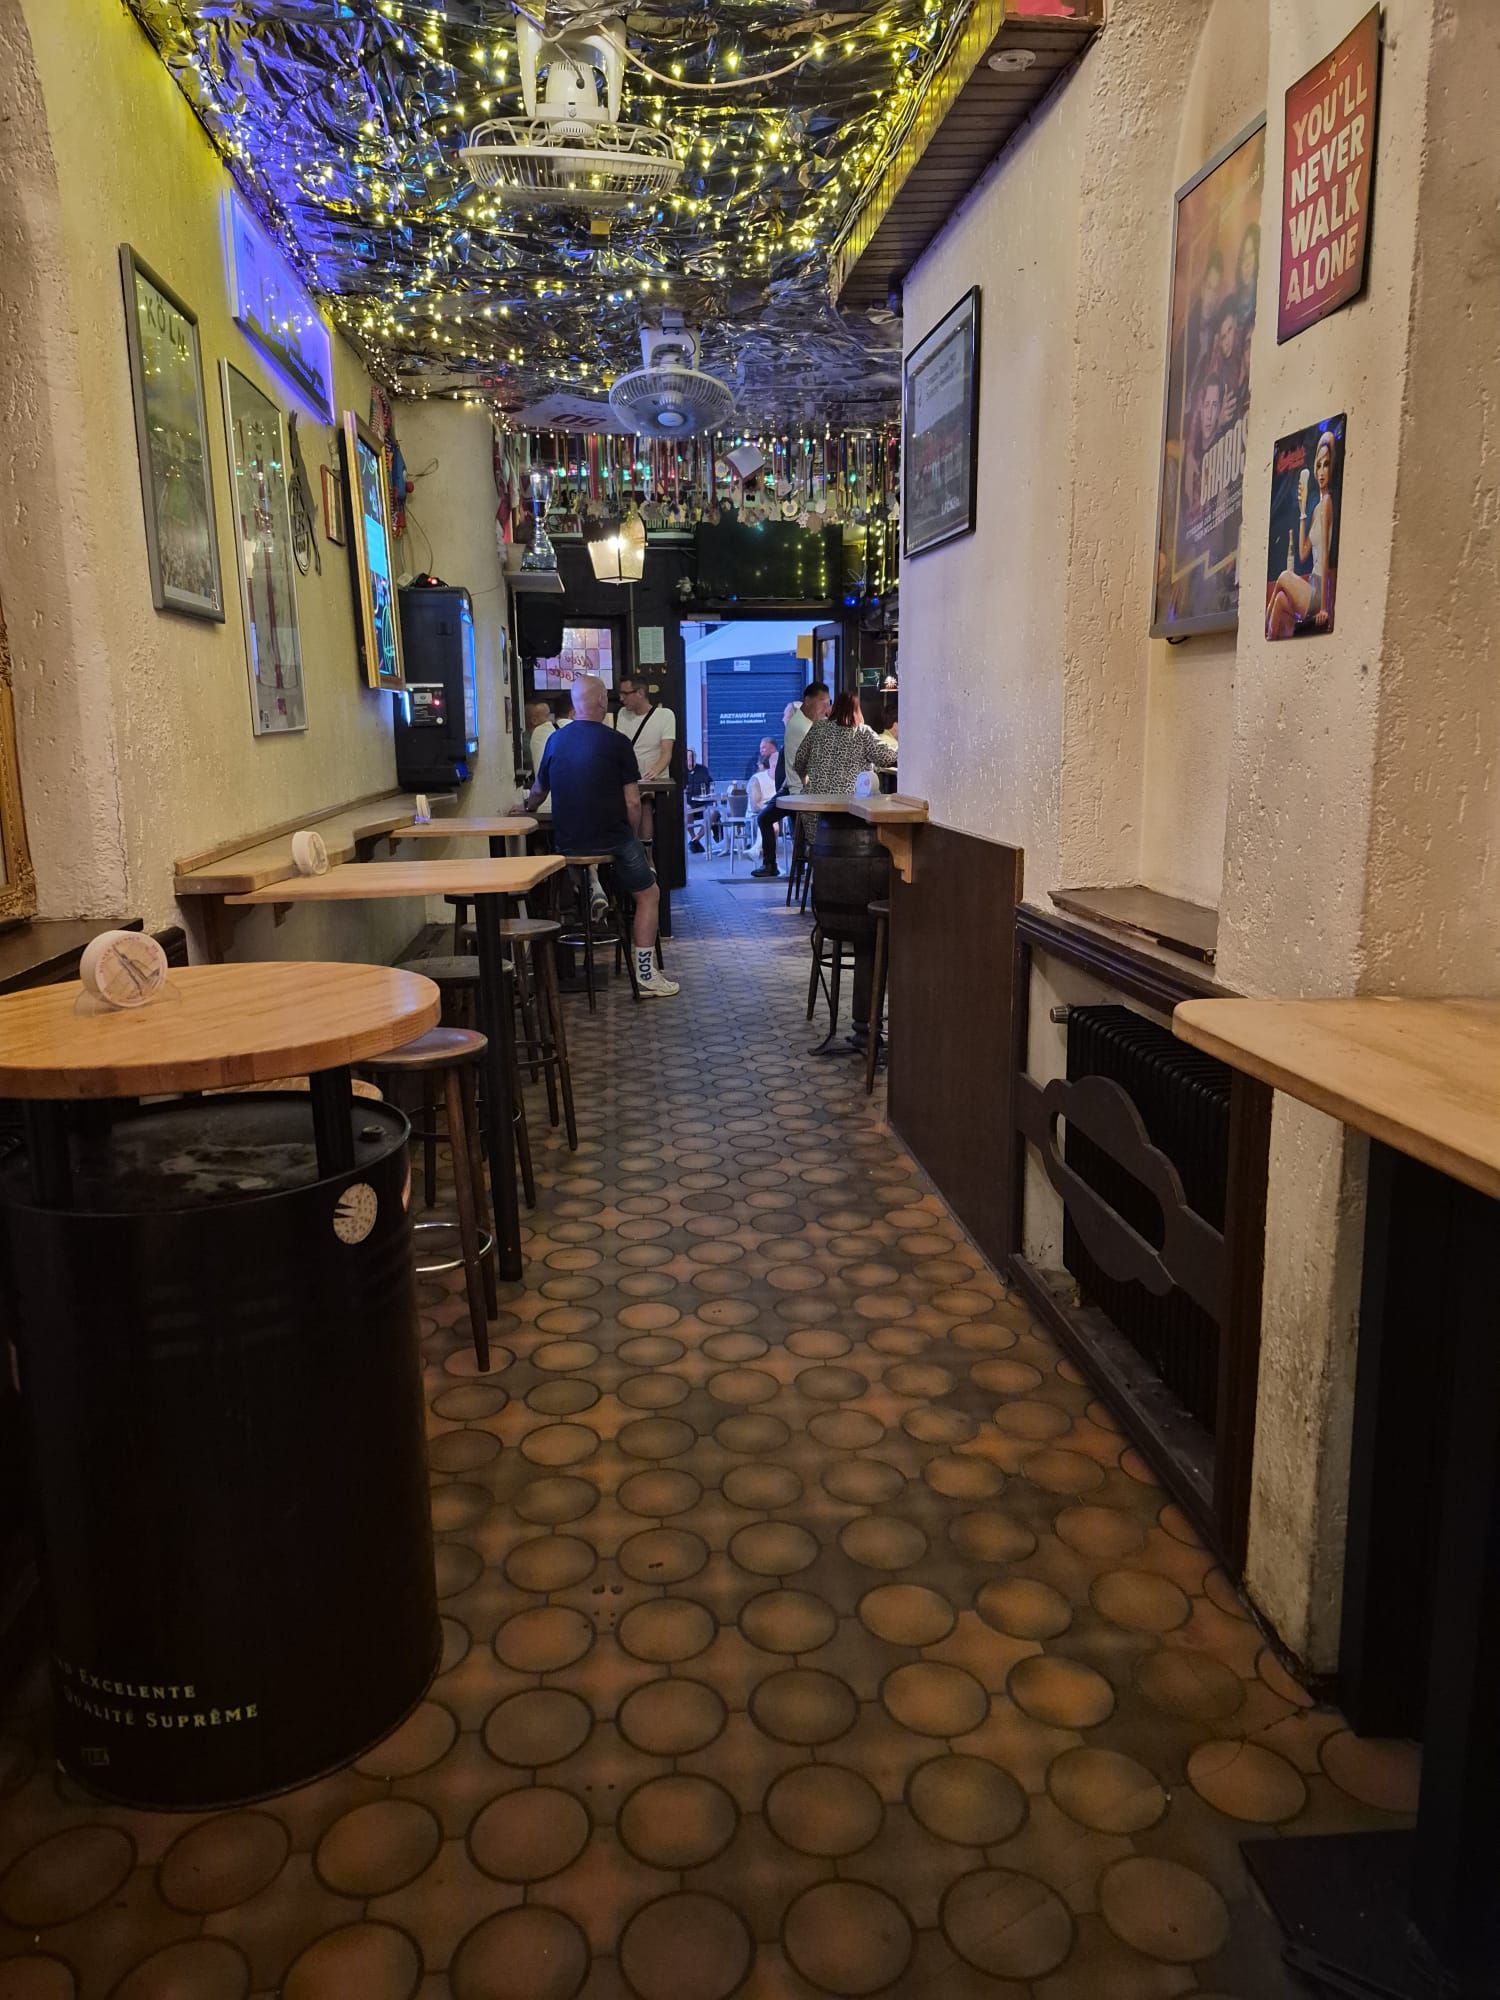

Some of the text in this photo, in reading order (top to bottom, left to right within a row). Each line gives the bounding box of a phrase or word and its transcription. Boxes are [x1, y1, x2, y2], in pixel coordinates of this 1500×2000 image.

[1292, 62, 1368, 157] YOU'LL
[1290, 113, 1366, 209] NEVER
[1288, 164, 1362, 259] WALK
[1285, 223, 1359, 310] ALONE
[144, 294, 186, 357] KÖLN
[638, 951, 653, 981] BOSS
